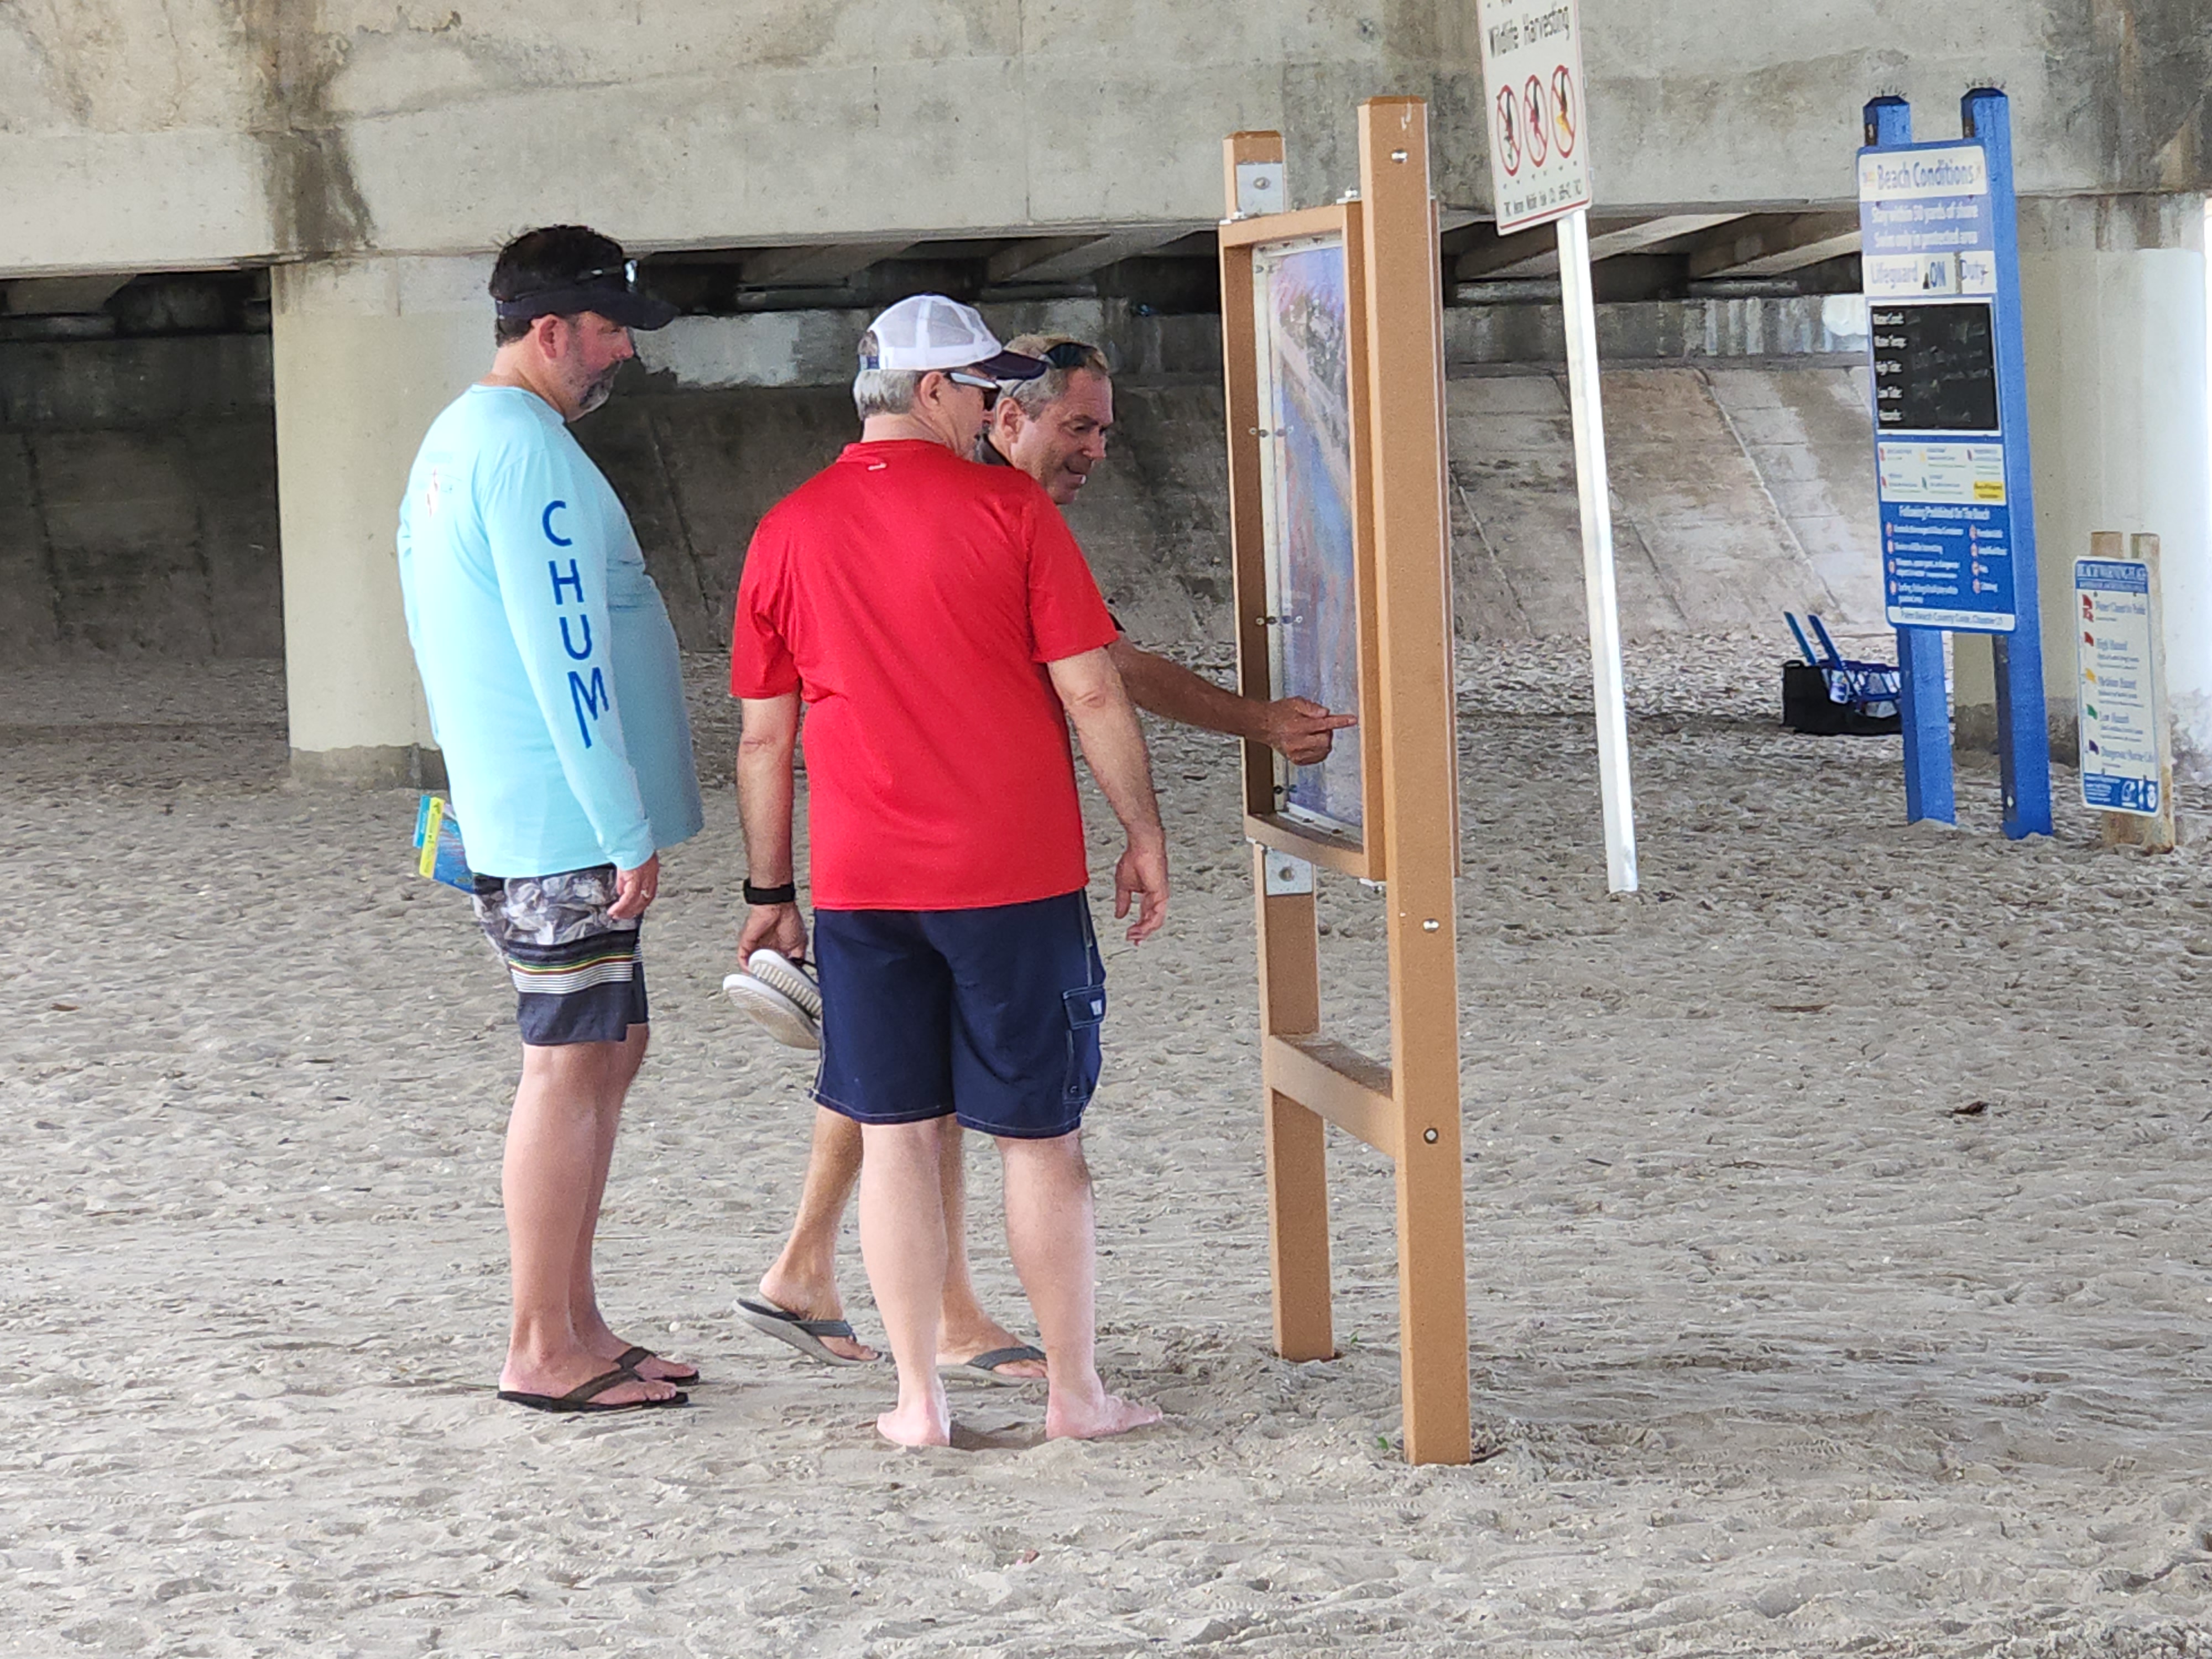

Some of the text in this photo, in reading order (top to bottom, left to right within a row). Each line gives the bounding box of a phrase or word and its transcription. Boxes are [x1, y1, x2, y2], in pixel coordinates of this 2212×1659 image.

[1522, 1, 1570, 45] Harvesting
[1877, 158, 1974, 190] Beach Conditions
[1870, 259, 1987, 290] Lifeguard ON Duty
[542, 500, 609, 748] CHUM
